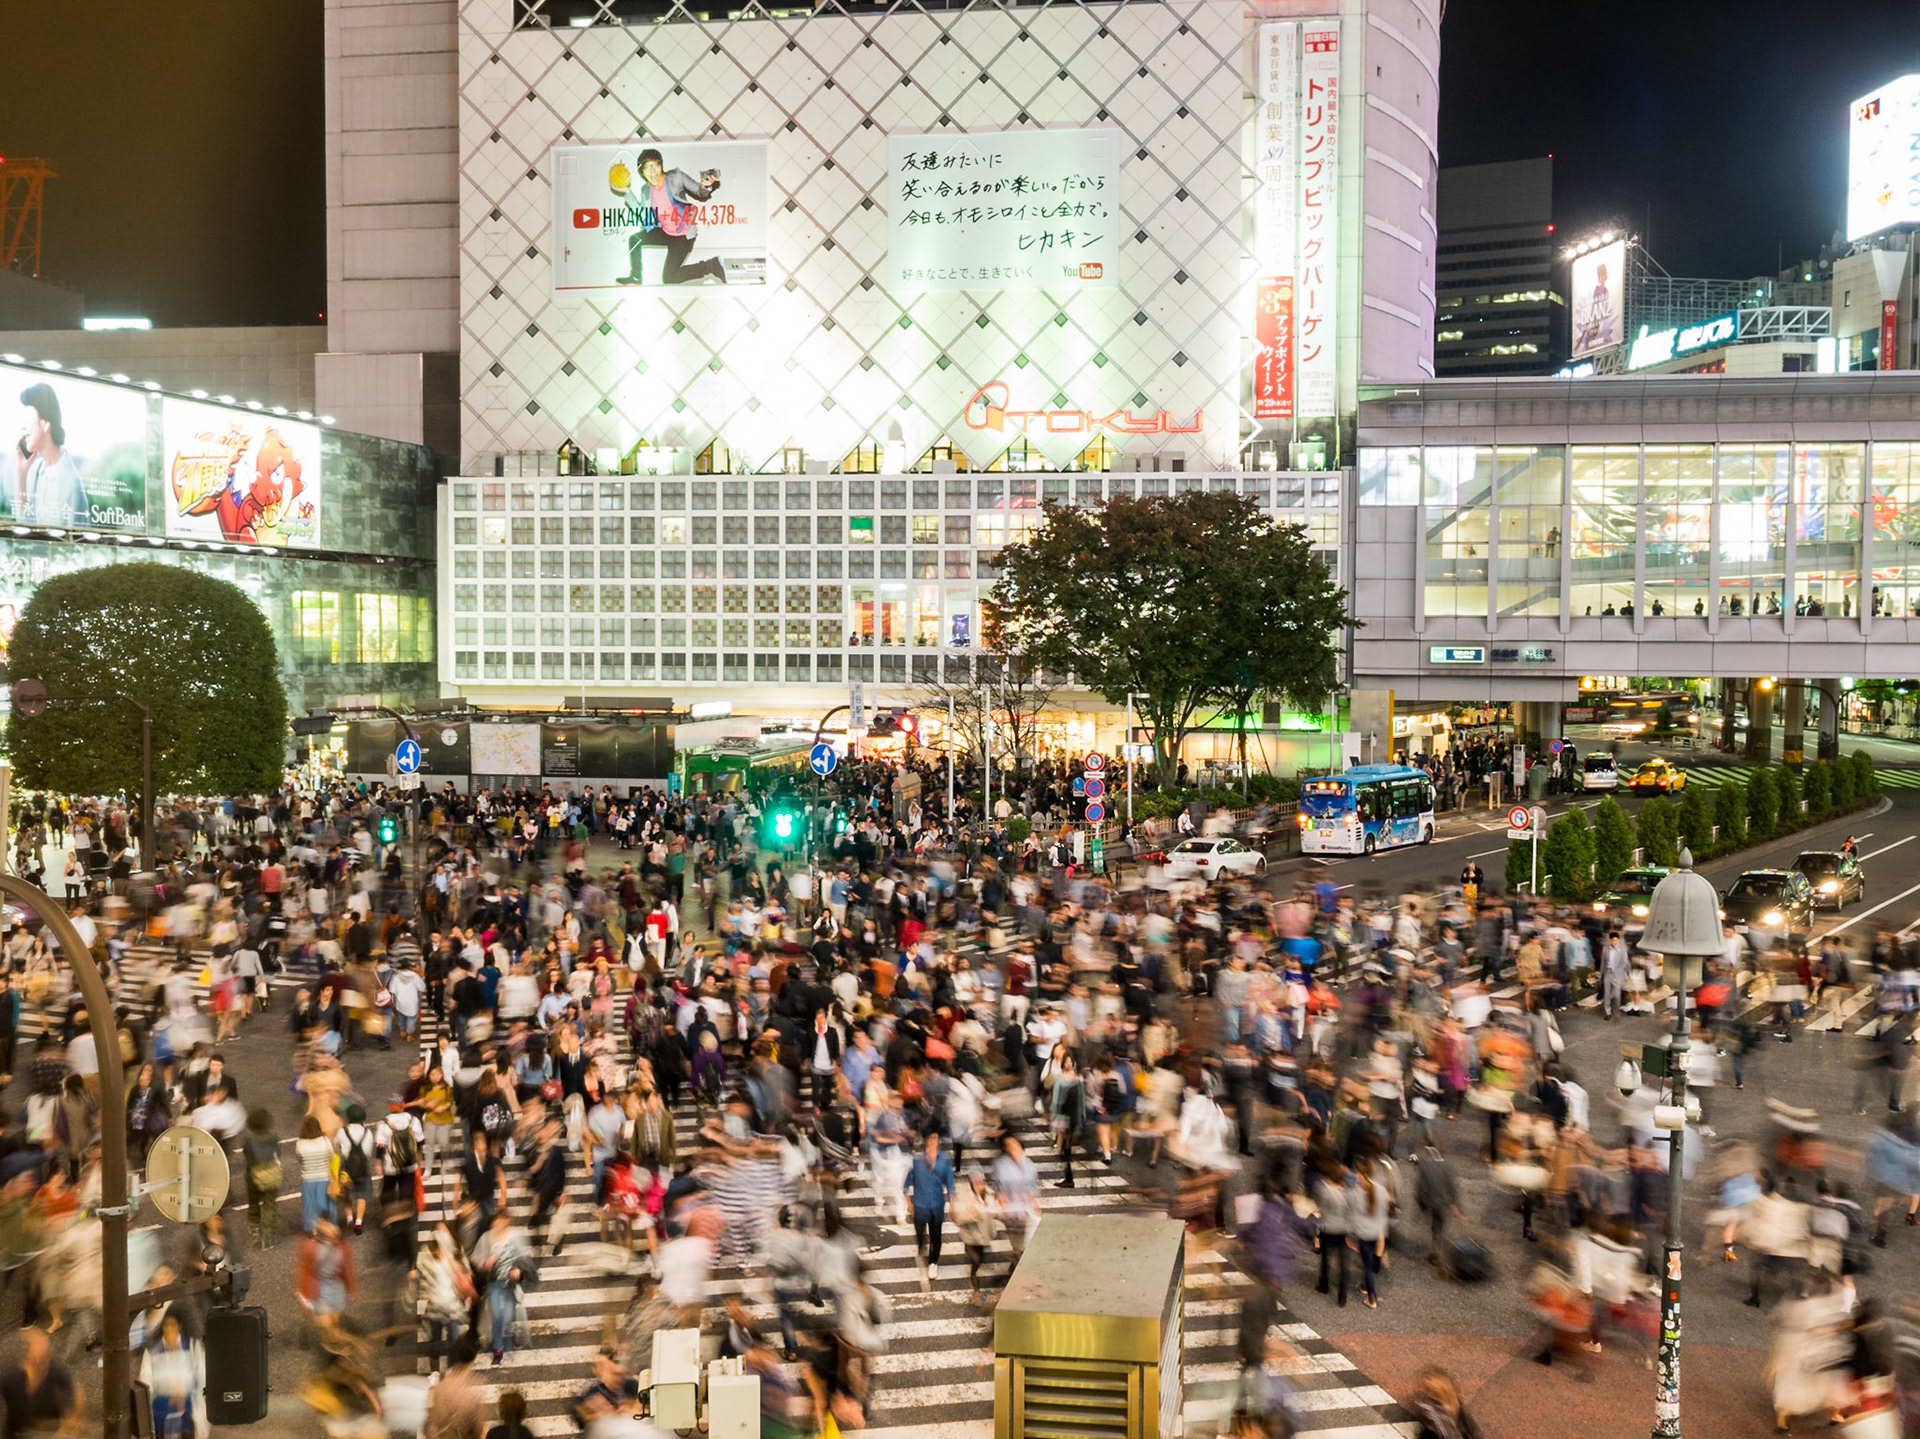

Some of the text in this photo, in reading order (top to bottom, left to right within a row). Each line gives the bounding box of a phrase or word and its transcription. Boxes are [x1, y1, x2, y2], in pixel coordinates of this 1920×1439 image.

[901, 152, 1003, 171] 友達みたいに
[901, 174, 1106, 201] 笑い合えるのが楽しい。だから
[603, 207, 658, 228] HIKAKIN
[1302, 78, 1325, 363] トリンプビッグバーゲン
[603, 228, 626, 236] ヒカキン
[1018, 229, 1104, 253] ヒカキン
[902, 266, 1033, 281] 好きなことで、生きていく
[1063, 263, 1103, 280] YouTube
[1275, 315, 1288, 396] アップポイント
[1005, 410, 1203, 433] TOKYU
[10, 500, 145, 527] 吉永百合 SoftBank
